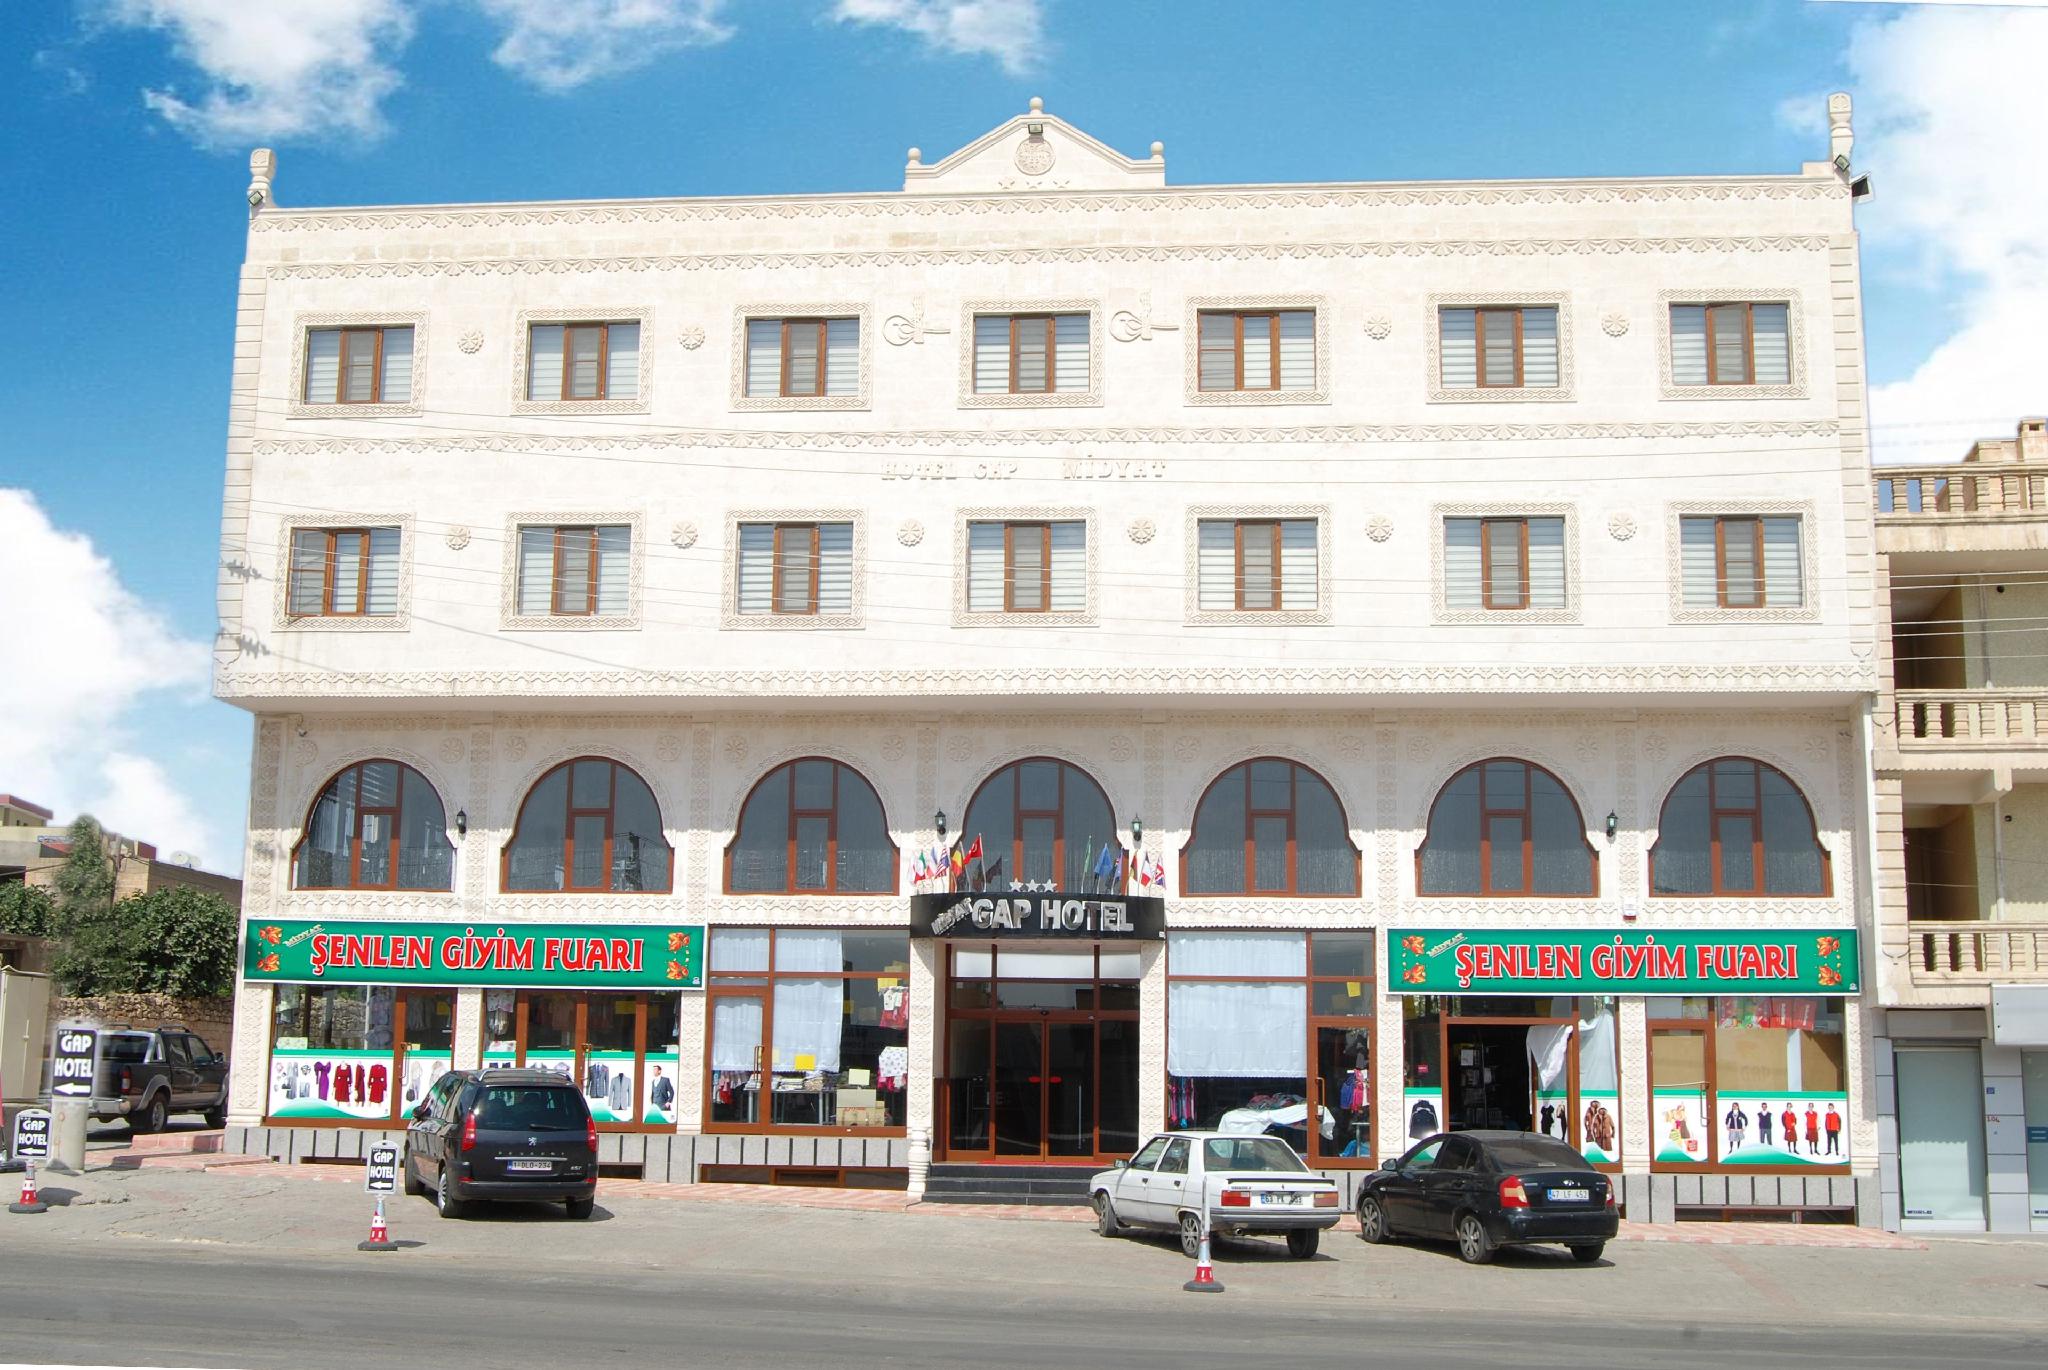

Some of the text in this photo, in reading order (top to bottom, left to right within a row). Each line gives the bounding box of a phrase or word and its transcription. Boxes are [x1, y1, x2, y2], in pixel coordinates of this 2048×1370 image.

[971, 898, 1032, 929] GAP
[1040, 898, 1135, 932] HOTEL
[310, 926, 645, 976] ŞENLEN GİYİM FUARI
[1455, 934, 1799, 989] ŞENLEN GİYİM FUARI
[61, 1034, 92, 1053] GAP
[54, 1058, 93, 1078] HOTEL
[22, 1120, 46, 1131] GAP
[18, 1133, 48, 1146] HOTEL
[373, 1152, 394, 1163] GAP
[370, 1166, 394, 1179] HOTEL
